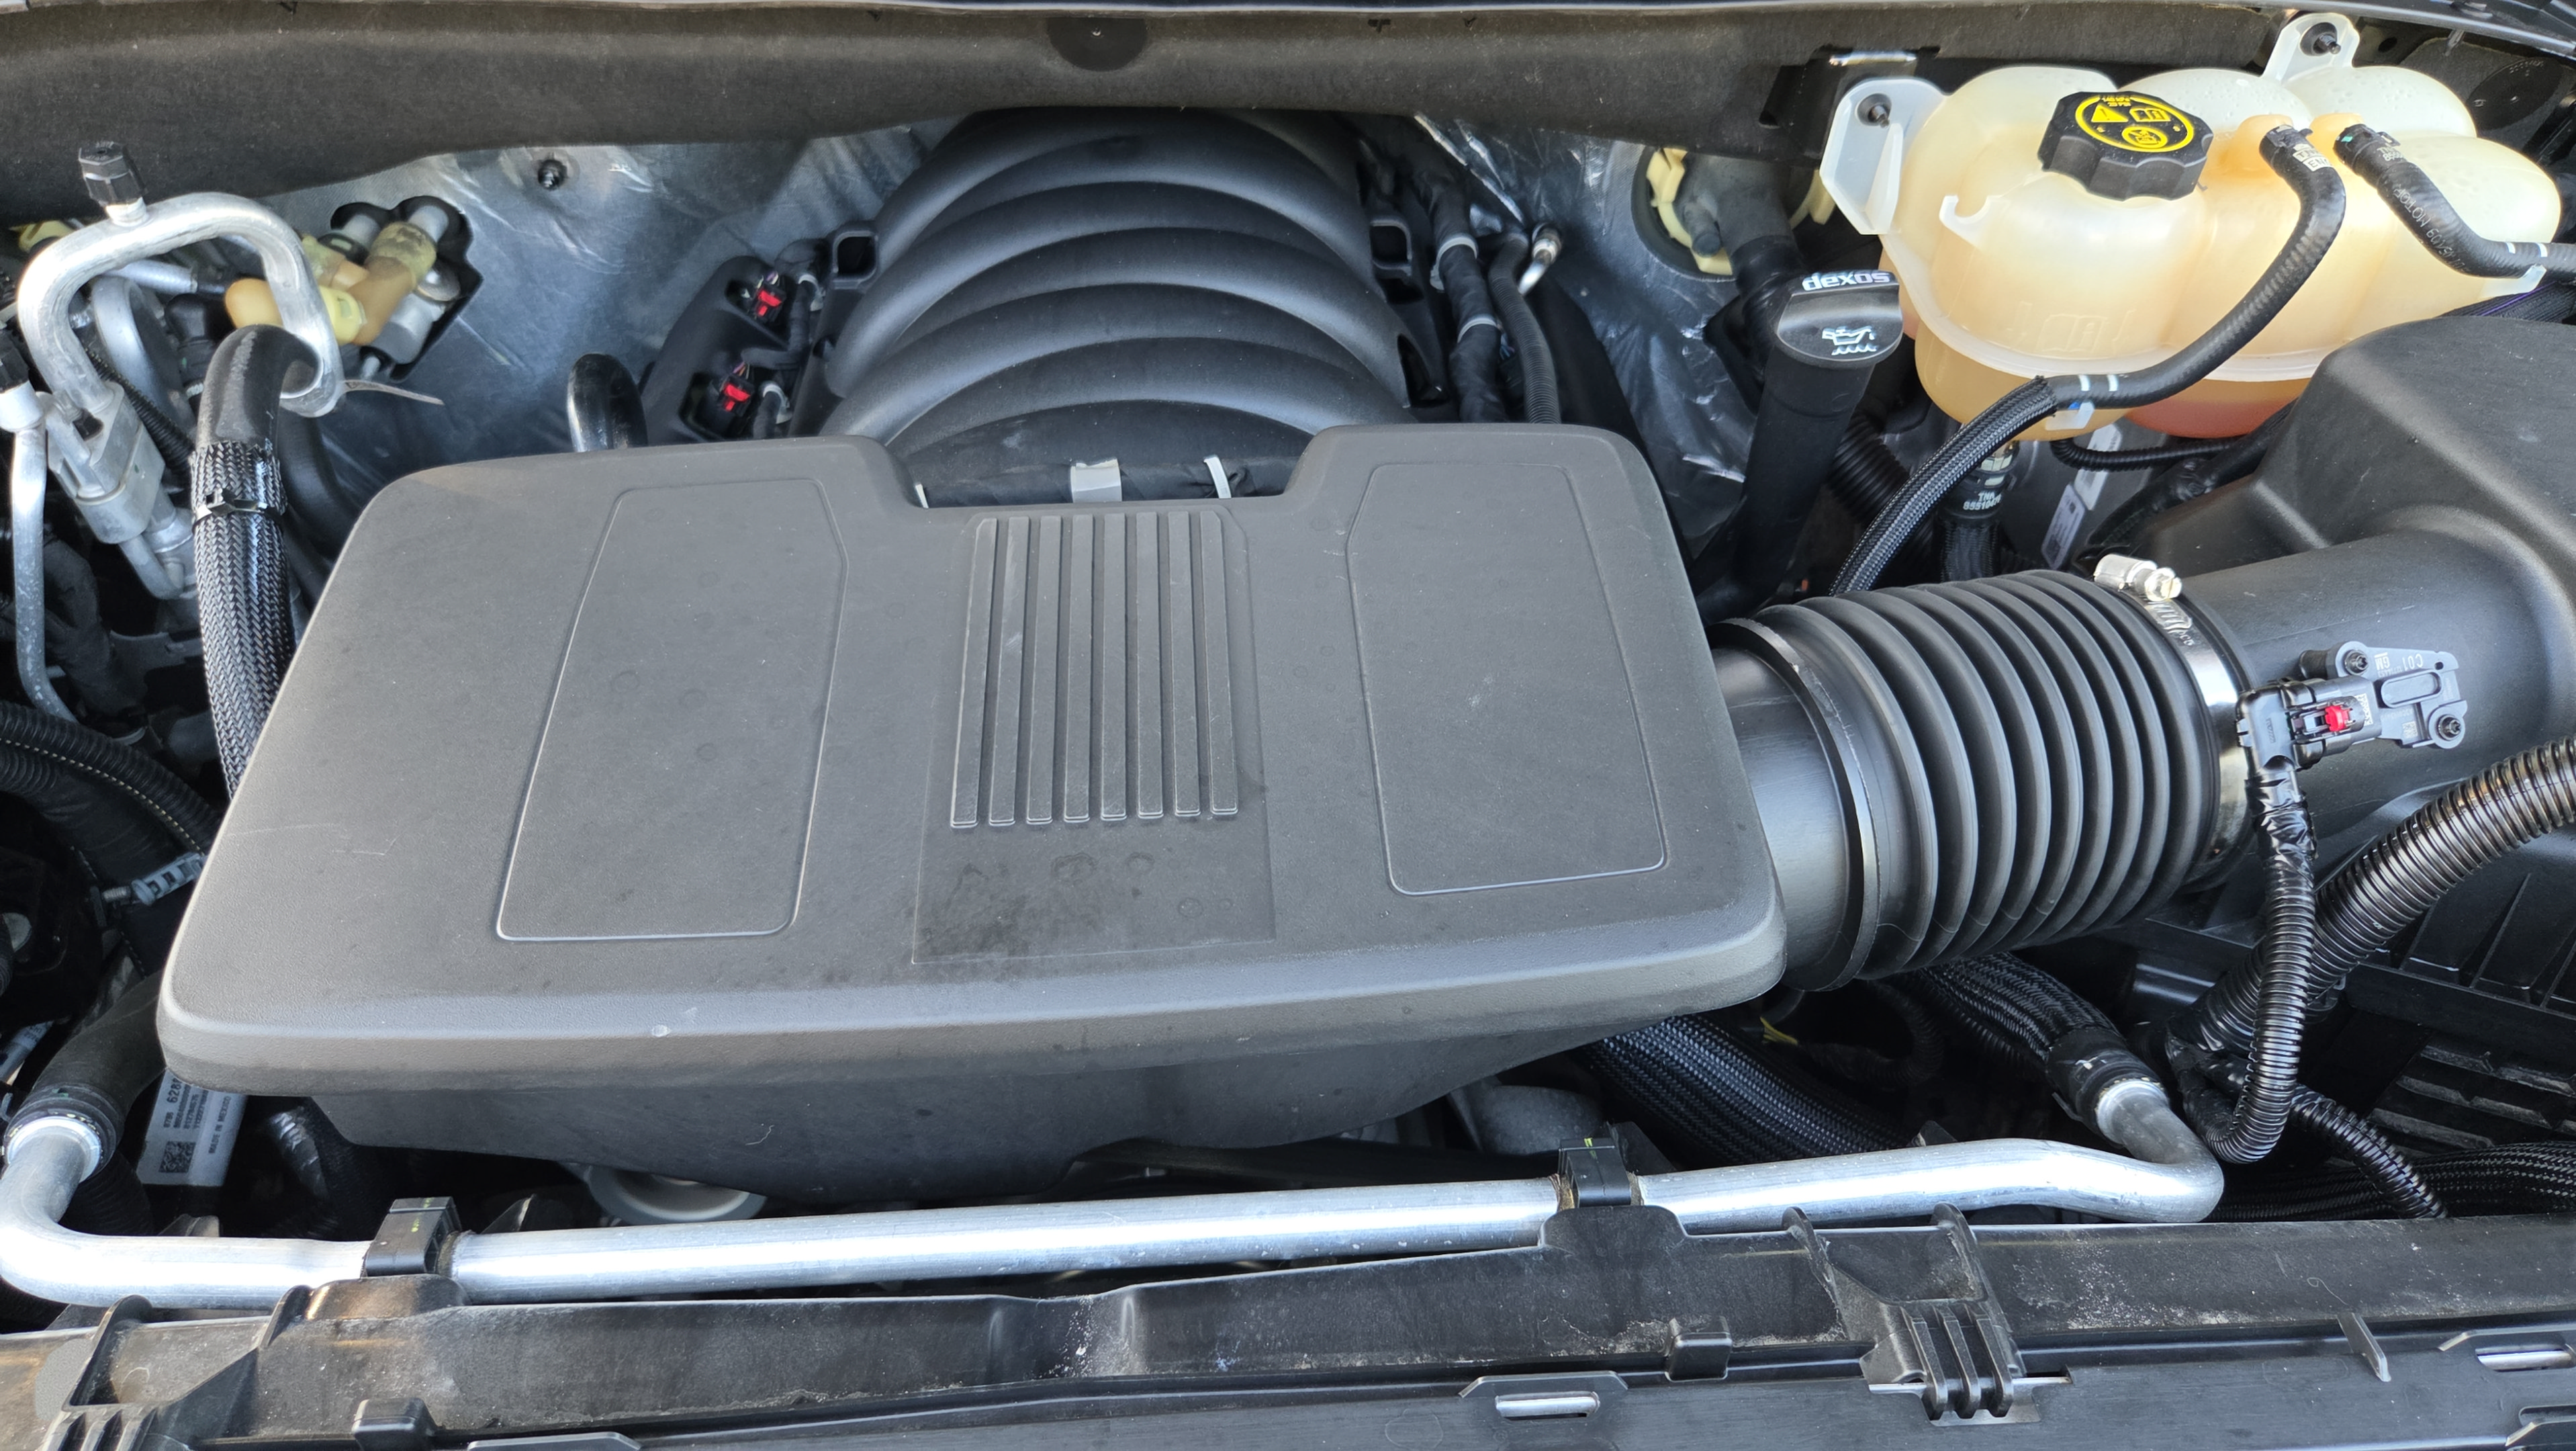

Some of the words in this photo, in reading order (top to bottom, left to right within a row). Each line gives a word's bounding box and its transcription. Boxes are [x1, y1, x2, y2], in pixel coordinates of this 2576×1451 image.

[1802, 271, 1890, 291] dexos
[2375, 654, 2390, 670] GM
[218, 1096, 232, 1122] MEXICO
[215, 1124, 223, 1132] IN
[208, 1134, 220, 1154] MADE
